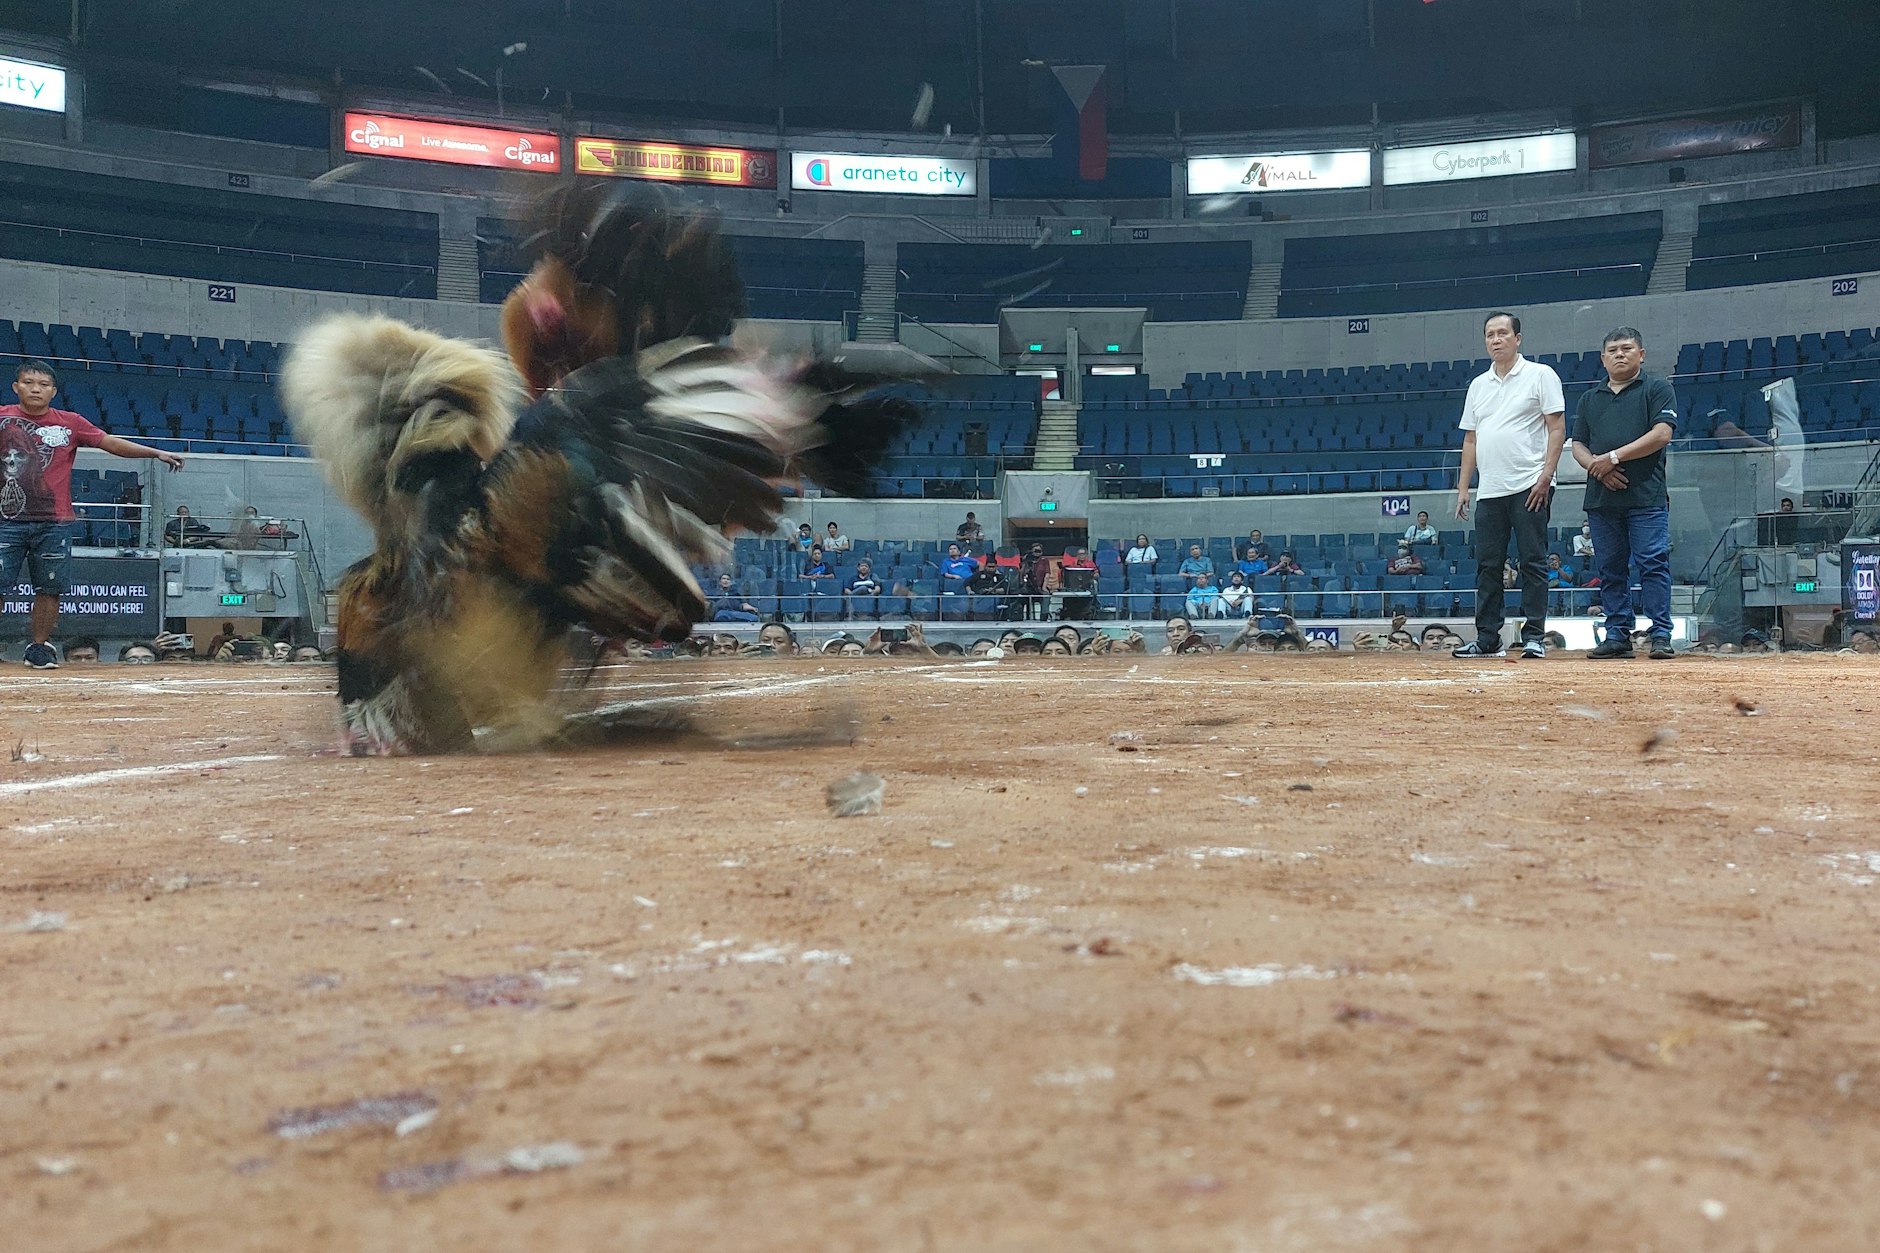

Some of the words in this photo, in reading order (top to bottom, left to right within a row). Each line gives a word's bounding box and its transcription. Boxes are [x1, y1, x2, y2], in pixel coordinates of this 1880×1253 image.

[0, 70, 45, 99] ity
[350, 122, 404, 149] Cignal
[421, 136, 441, 147] Live
[504, 138, 554, 165] Cignal
[613, 149, 735, 174] THUNDERBIRD
[1432, 149, 1512, 176] Cyberpark
[1518, 148, 1525, 169] 1
[229, 175, 248, 185] 423
[843, 166, 918, 182] araneta
[927, 166, 967, 188] city
[1472, 212, 1487, 221] 402
[1133, 230, 1148, 238] 401
[1833, 281, 1857, 293] 202
[210, 287, 234, 300] 221
[1350, 321, 1369, 332] 201
[1383, 499, 1409, 512] 104
[90, 585, 109, 597] YOU
[110, 585, 127, 597] CAN
[128, 585, 148, 597] FEEL
[1795, 582, 1815, 591] EXIT
[222, 595, 244, 605] EXIT
[79, 602, 109, 614] SOUND
[110, 602, 119, 614] IS
[120, 602, 144, 614] HERE!
